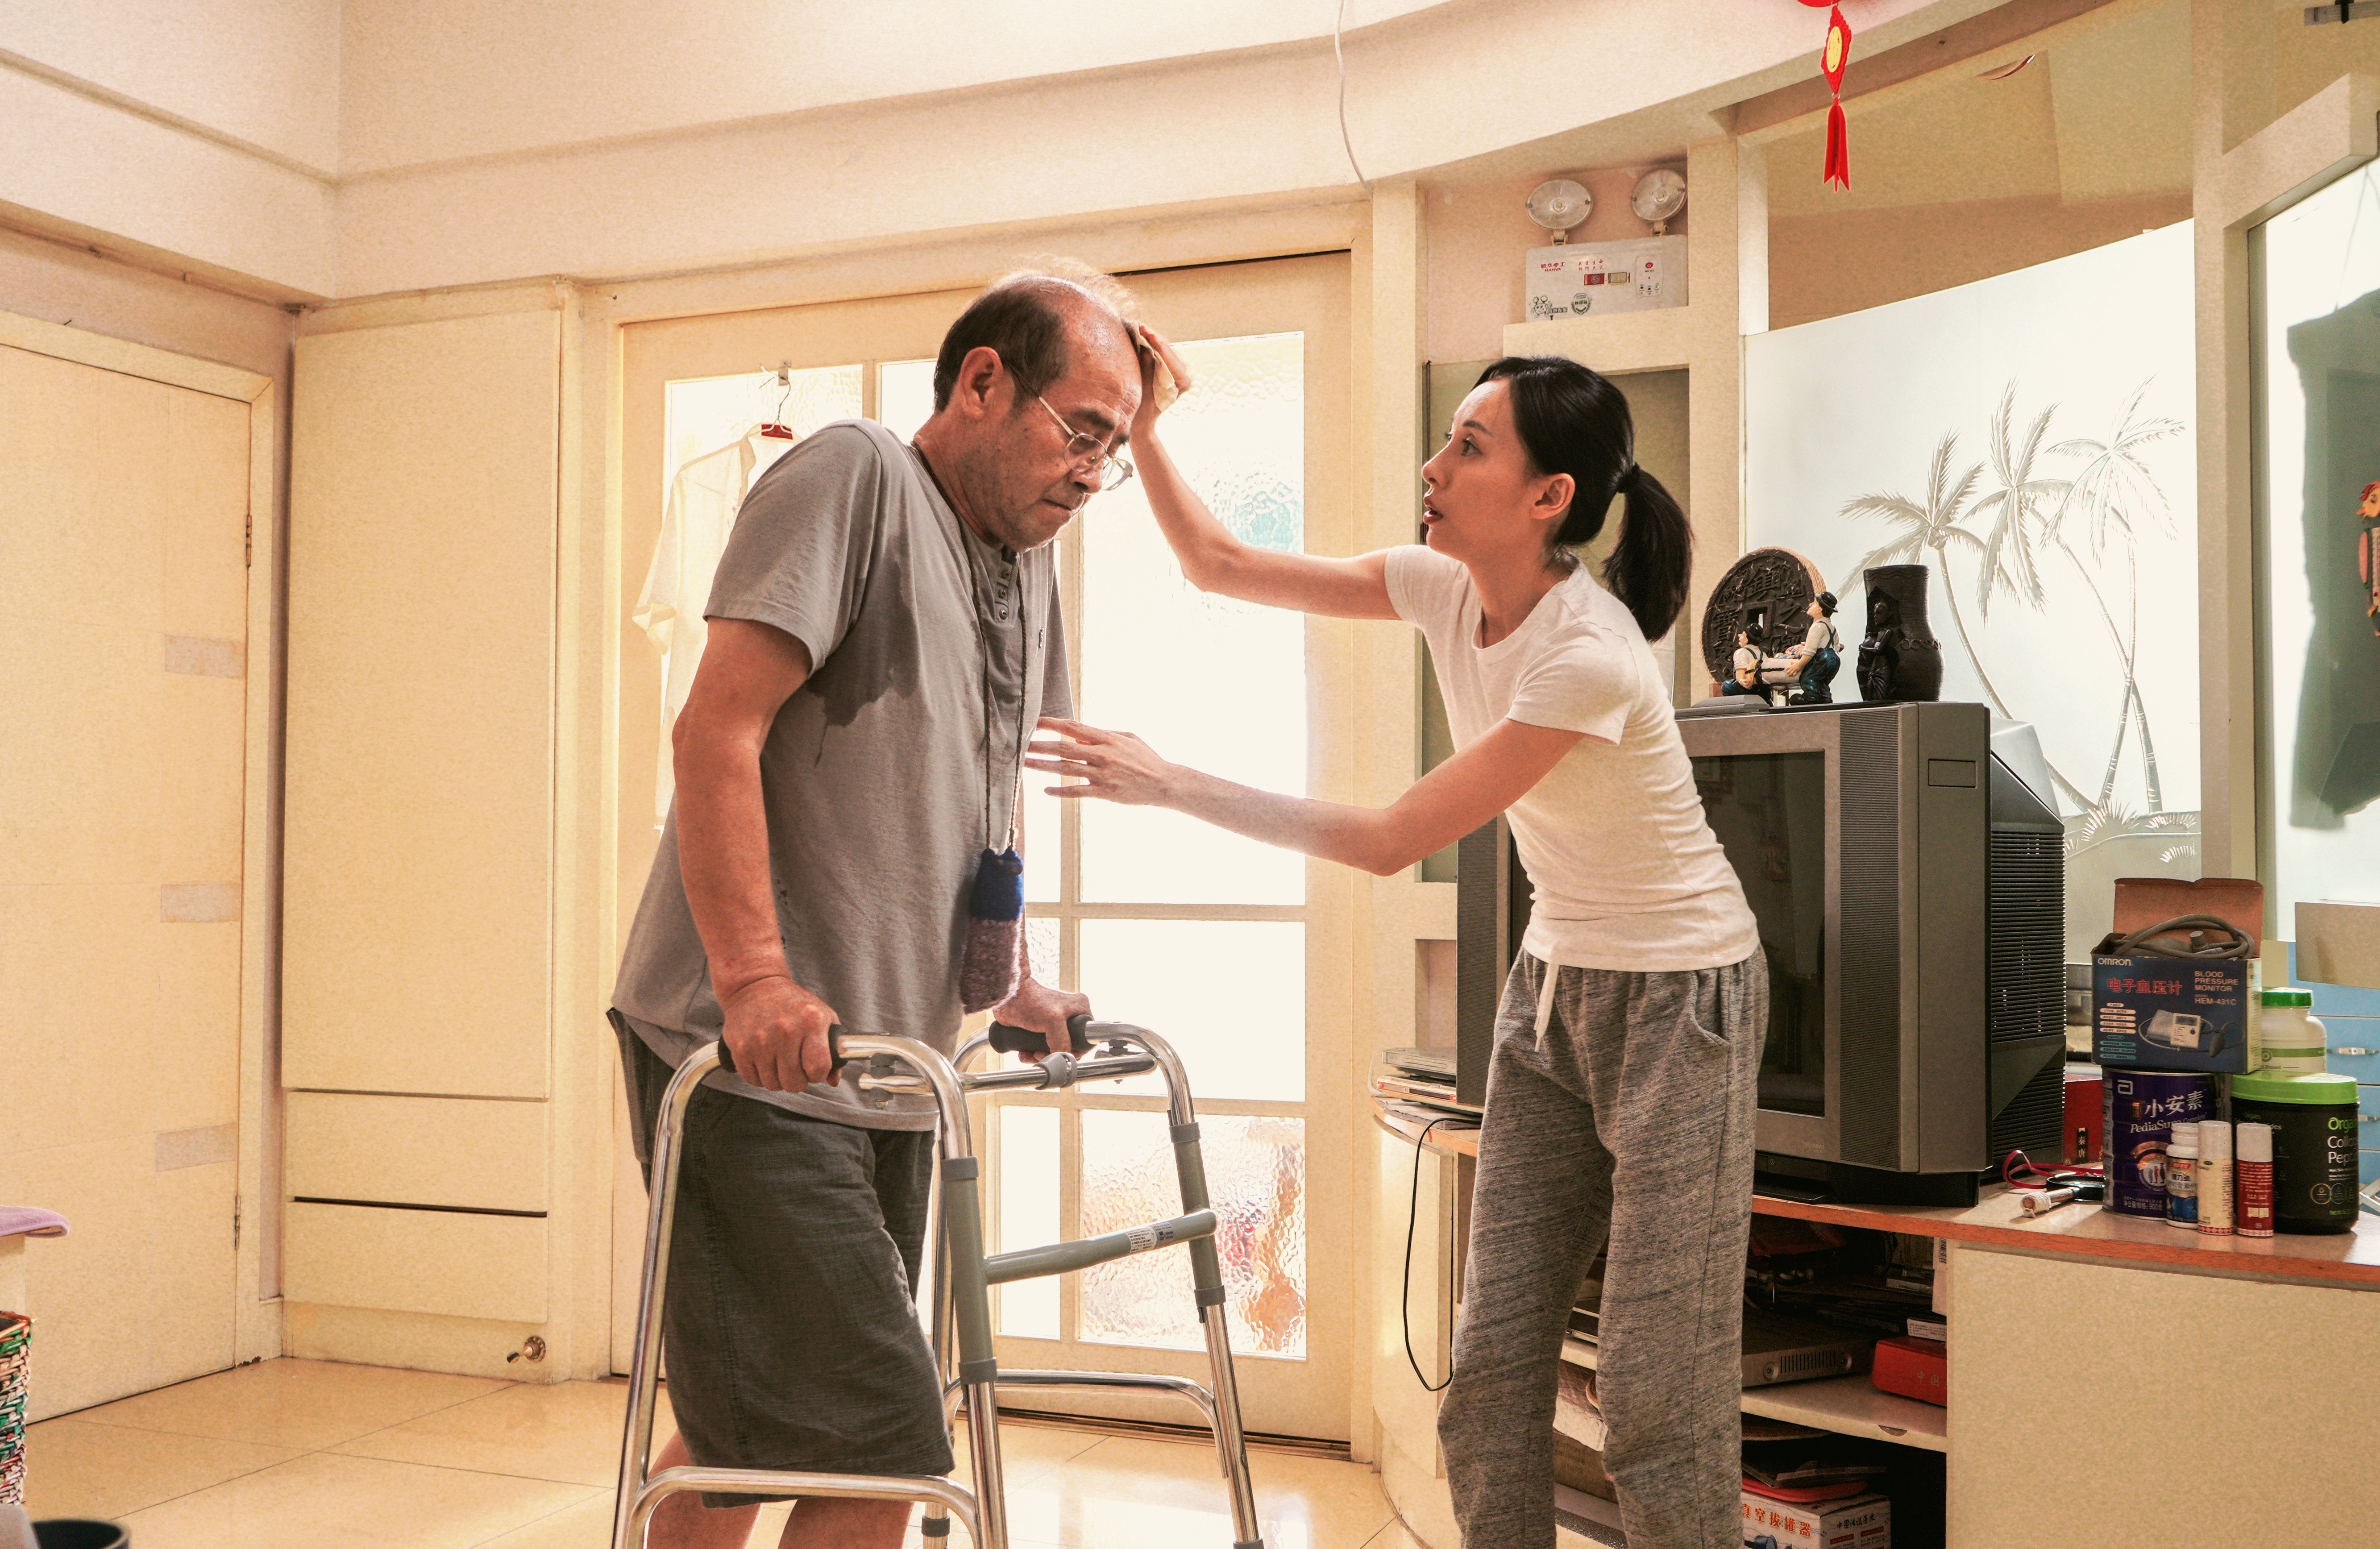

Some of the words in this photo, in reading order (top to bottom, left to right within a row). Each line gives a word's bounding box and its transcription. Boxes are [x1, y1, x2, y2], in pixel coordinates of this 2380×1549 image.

[2098, 957, 2131, 966] OMRON
[2107, 978, 2182, 995] 电子血压计
[2194, 997, 2237, 1005] HEM-431C
[2144, 1090, 2204, 1118] 小安素
[1741, 1503, 1811, 1538] 真空拔罐器
